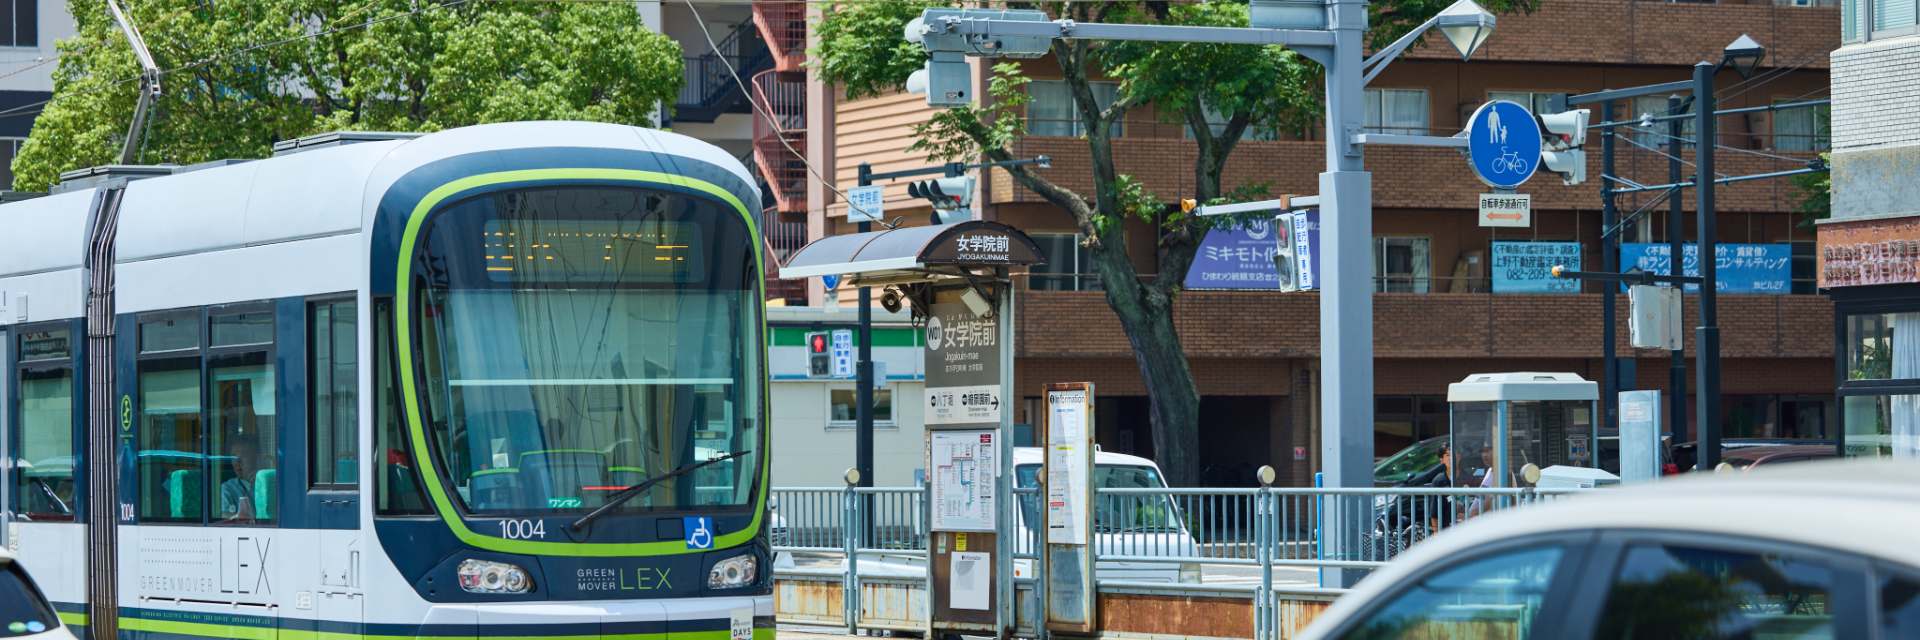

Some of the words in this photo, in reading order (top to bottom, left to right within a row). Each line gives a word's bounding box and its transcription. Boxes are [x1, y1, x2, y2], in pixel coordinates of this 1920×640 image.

[1481, 199, 1528, 209] 自転車歩道通行可
[956, 234, 1009, 252] 女学院前
[944, 320, 996, 348] 女学院前
[120, 503, 135, 521] 1004
[499, 519, 546, 540] 1004
[219, 536, 271, 595] LEX
[576, 568, 616, 578] GREEN
[577, 581, 617, 591] MOVER
[619, 567, 673, 590] LEX
[733, 627, 752, 637] DAYS
